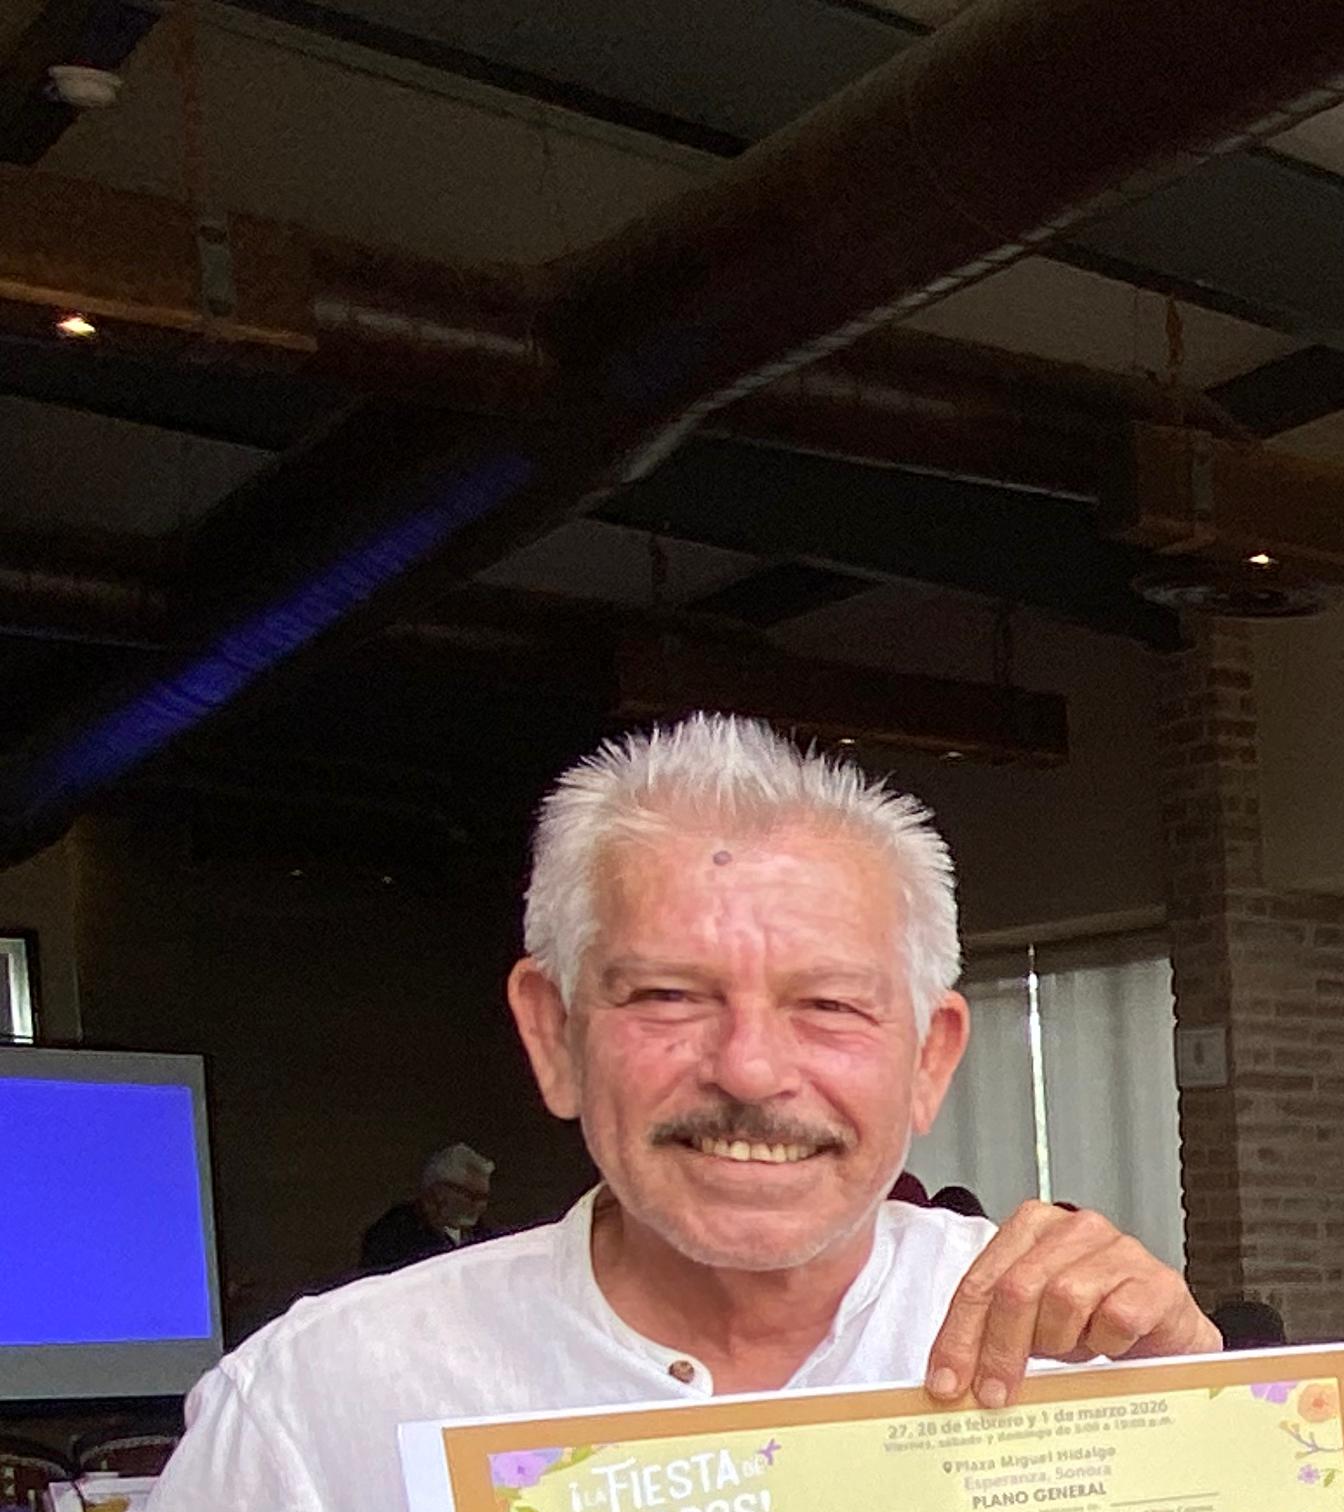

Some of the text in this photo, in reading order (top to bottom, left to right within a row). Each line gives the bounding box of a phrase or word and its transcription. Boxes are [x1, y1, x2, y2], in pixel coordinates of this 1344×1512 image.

[941, 1419, 962, 1434] de
[964, 1413, 1025, 1431] febrero
[1027, 1415, 1037, 1429] y
[1053, 1408, 1075, 1423] de
[1077, 1404, 1127, 1420] marzo
[1129, 1398, 1169, 1416] 2026
[742, 1456, 767, 1478] DE
[955, 1445, 1117, 1473] Plaza Miguel Hidalgo
[1055, 1464, 1113, 1482] Sonora
[971, 1481, 1107, 1510] PLANO GENERAL
